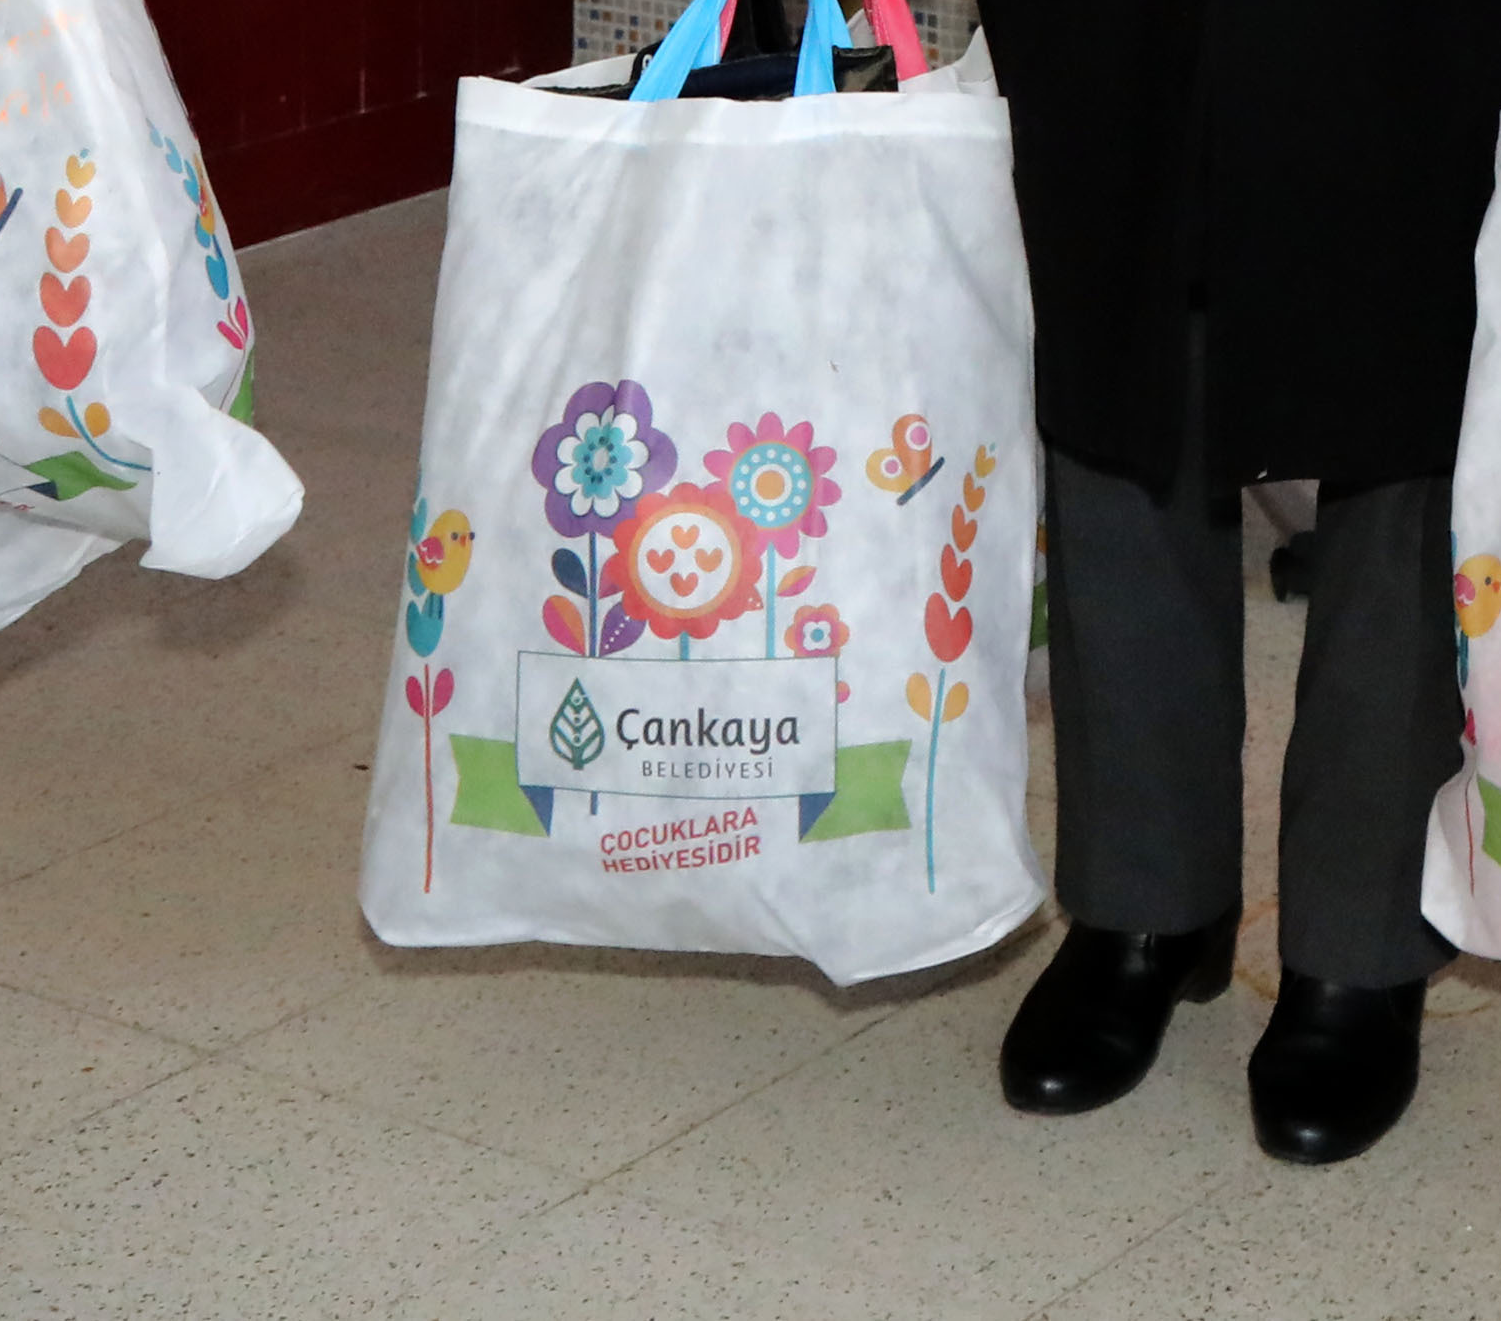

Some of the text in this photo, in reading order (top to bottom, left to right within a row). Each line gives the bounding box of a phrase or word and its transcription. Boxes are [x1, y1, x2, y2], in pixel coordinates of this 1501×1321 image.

[614, 706, 801, 756] Çankaya
[641, 755, 774, 781] BELEDİYESİ
[600, 805, 759, 857] ÇOCUKLARA
[602, 834, 762, 875] HEDİYESİDİR
